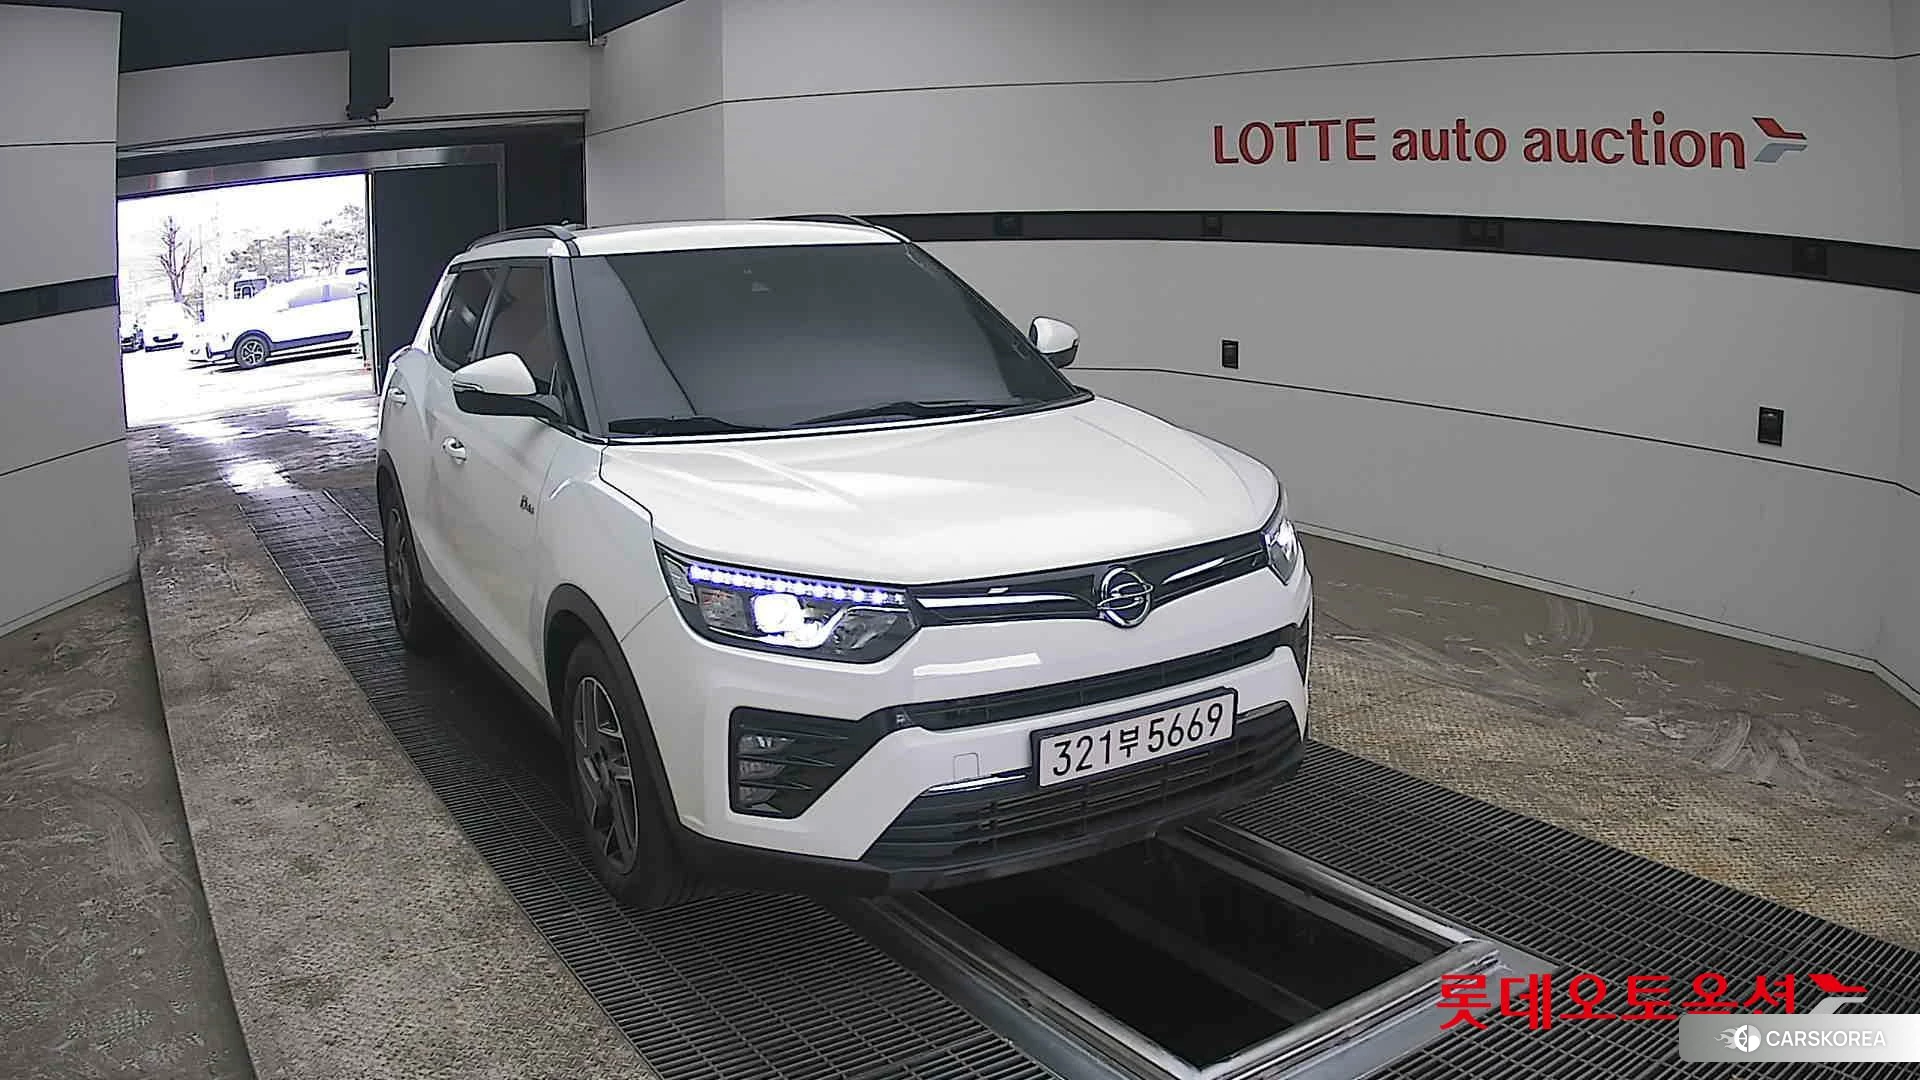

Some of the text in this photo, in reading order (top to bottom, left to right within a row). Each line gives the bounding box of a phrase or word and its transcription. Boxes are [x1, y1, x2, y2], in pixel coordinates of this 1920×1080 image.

[1213, 111, 1746, 170] LOTTE auto auction
